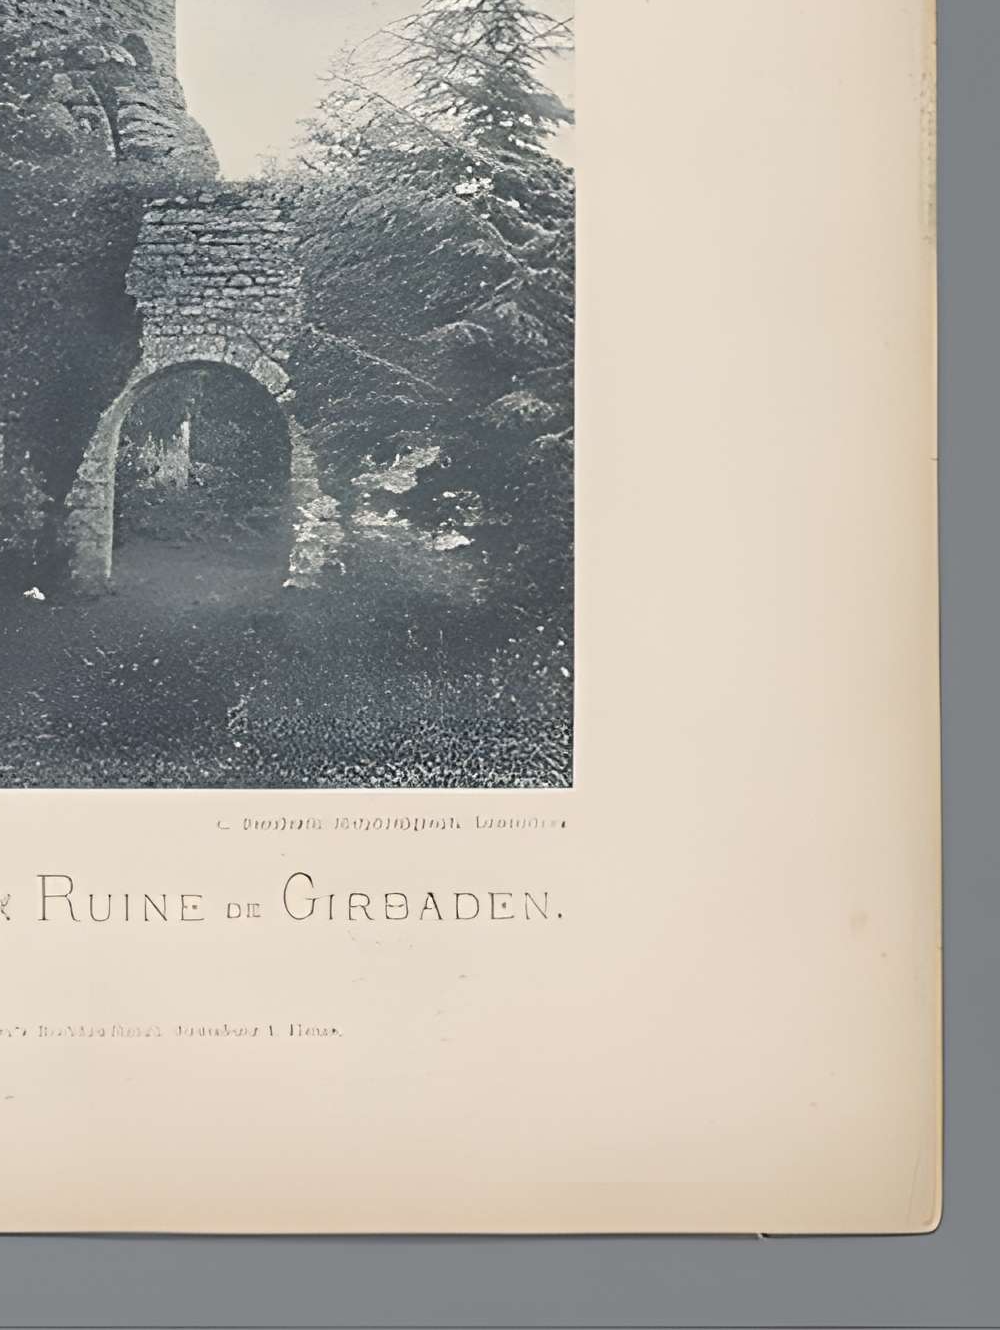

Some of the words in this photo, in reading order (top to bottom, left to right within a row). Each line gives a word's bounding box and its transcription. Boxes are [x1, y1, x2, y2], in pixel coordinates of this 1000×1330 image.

[36, 874, 205, 923] RUINE
[226, 902, 262, 920] DE
[282, 871, 564, 922] GIRBADEN.
